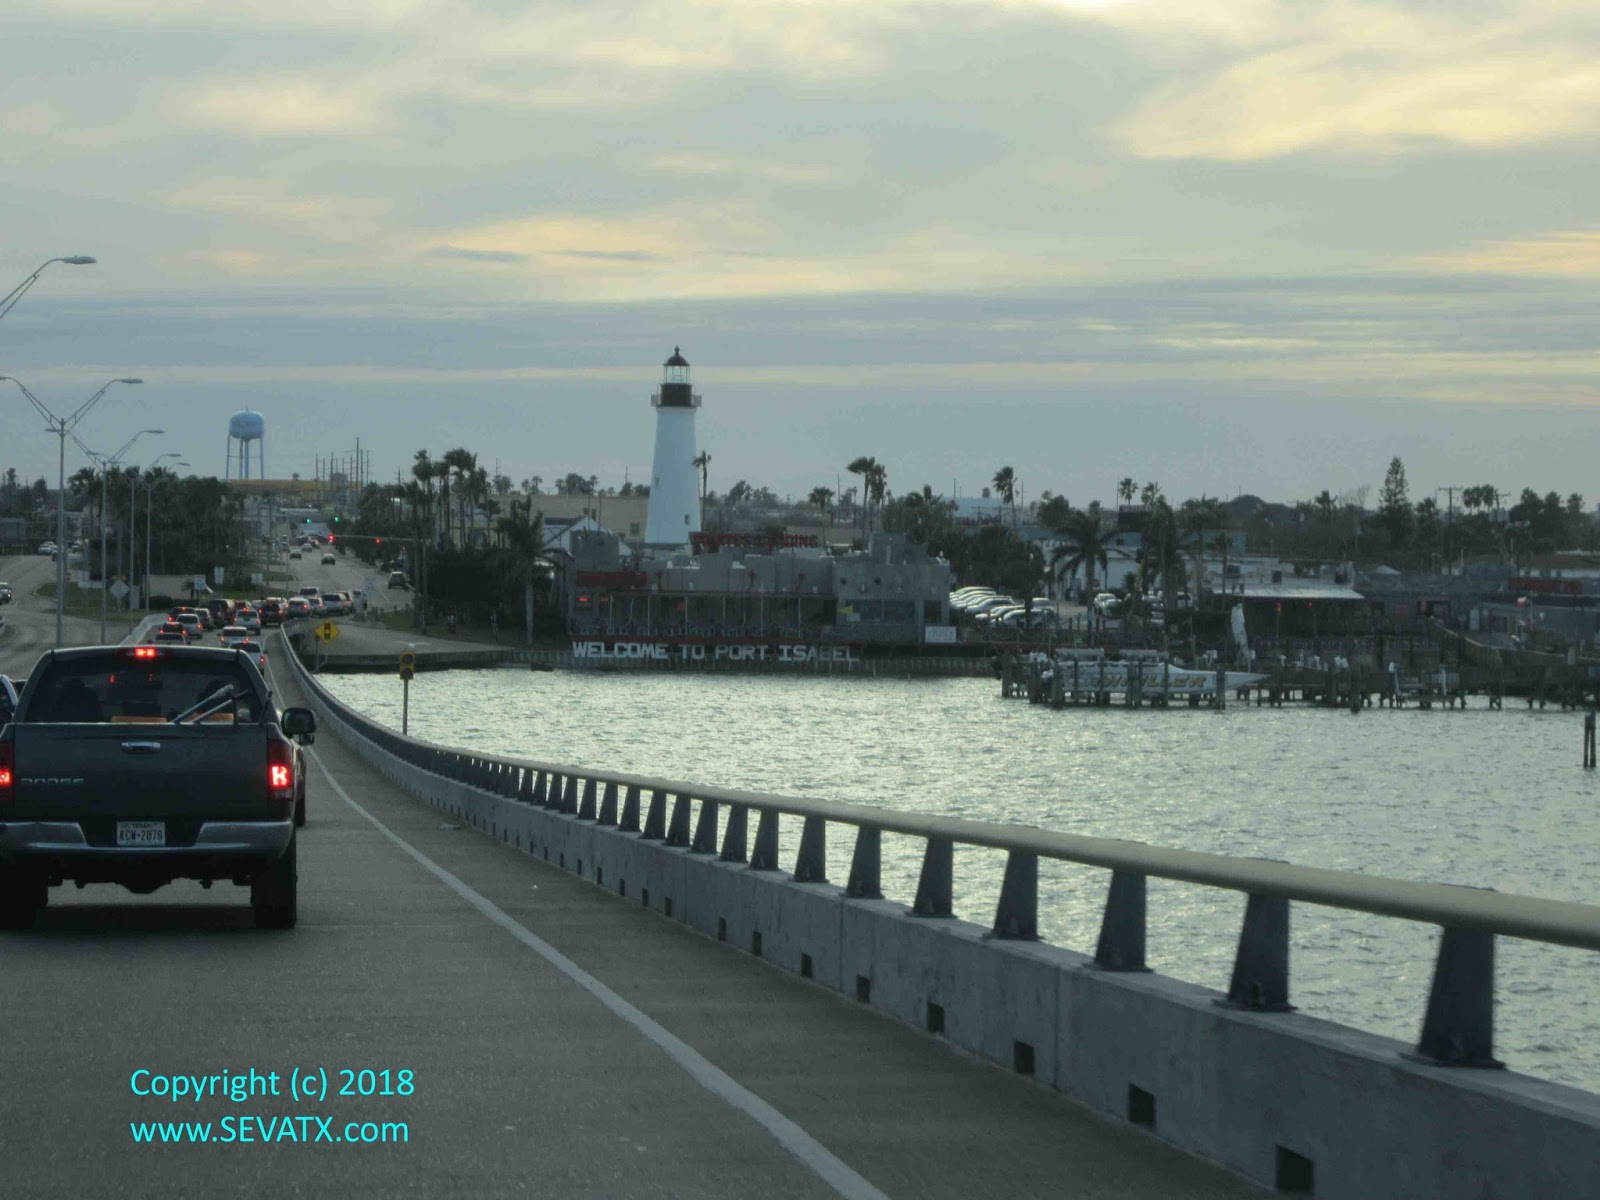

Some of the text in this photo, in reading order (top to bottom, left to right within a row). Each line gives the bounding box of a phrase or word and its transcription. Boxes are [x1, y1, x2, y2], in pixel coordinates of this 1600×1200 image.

[572, 641, 669, 660] WELCOME
[679, 643, 705, 661] TO
[714, 644, 769, 661] PORT
